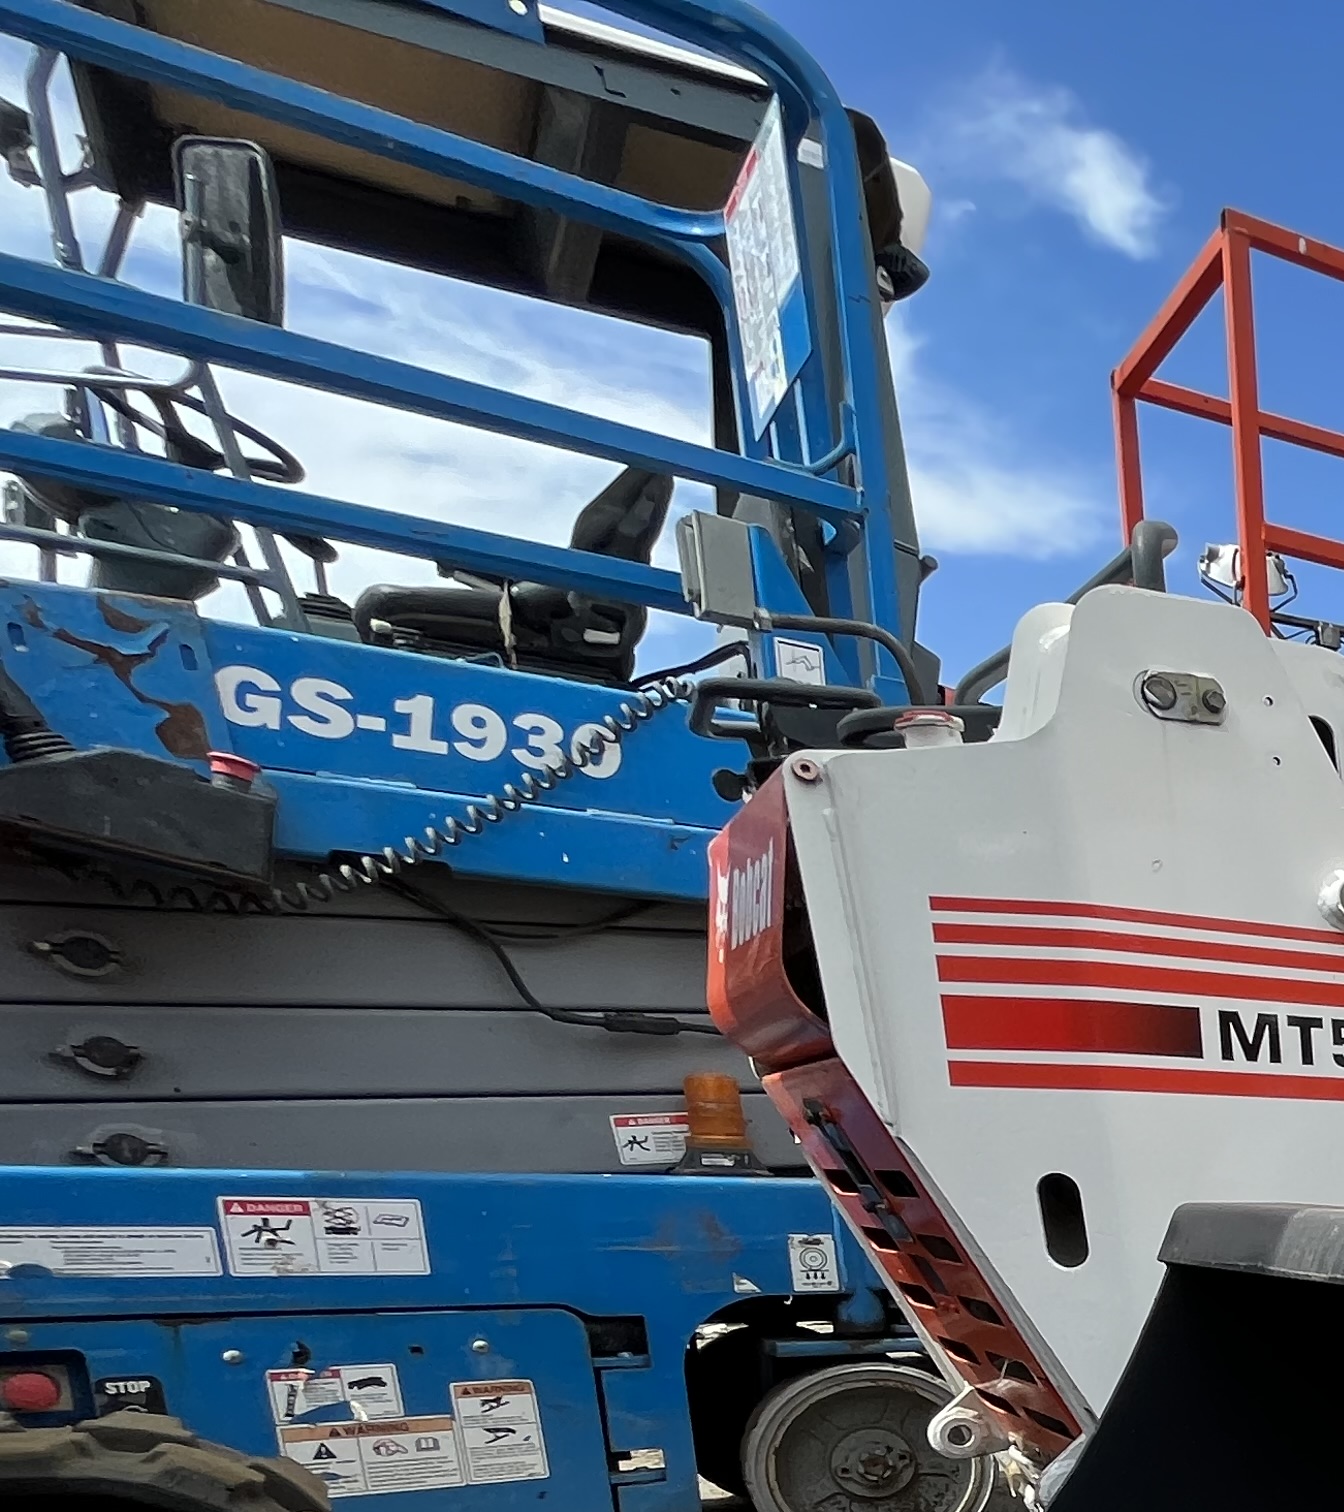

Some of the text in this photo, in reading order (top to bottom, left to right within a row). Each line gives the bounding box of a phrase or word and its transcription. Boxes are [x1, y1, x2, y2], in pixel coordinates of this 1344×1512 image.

[215, 665, 622, 779] GS-1930
[246, 1203, 304, 1213] DANGER
[105, 1380, 151, 1395] STOP
